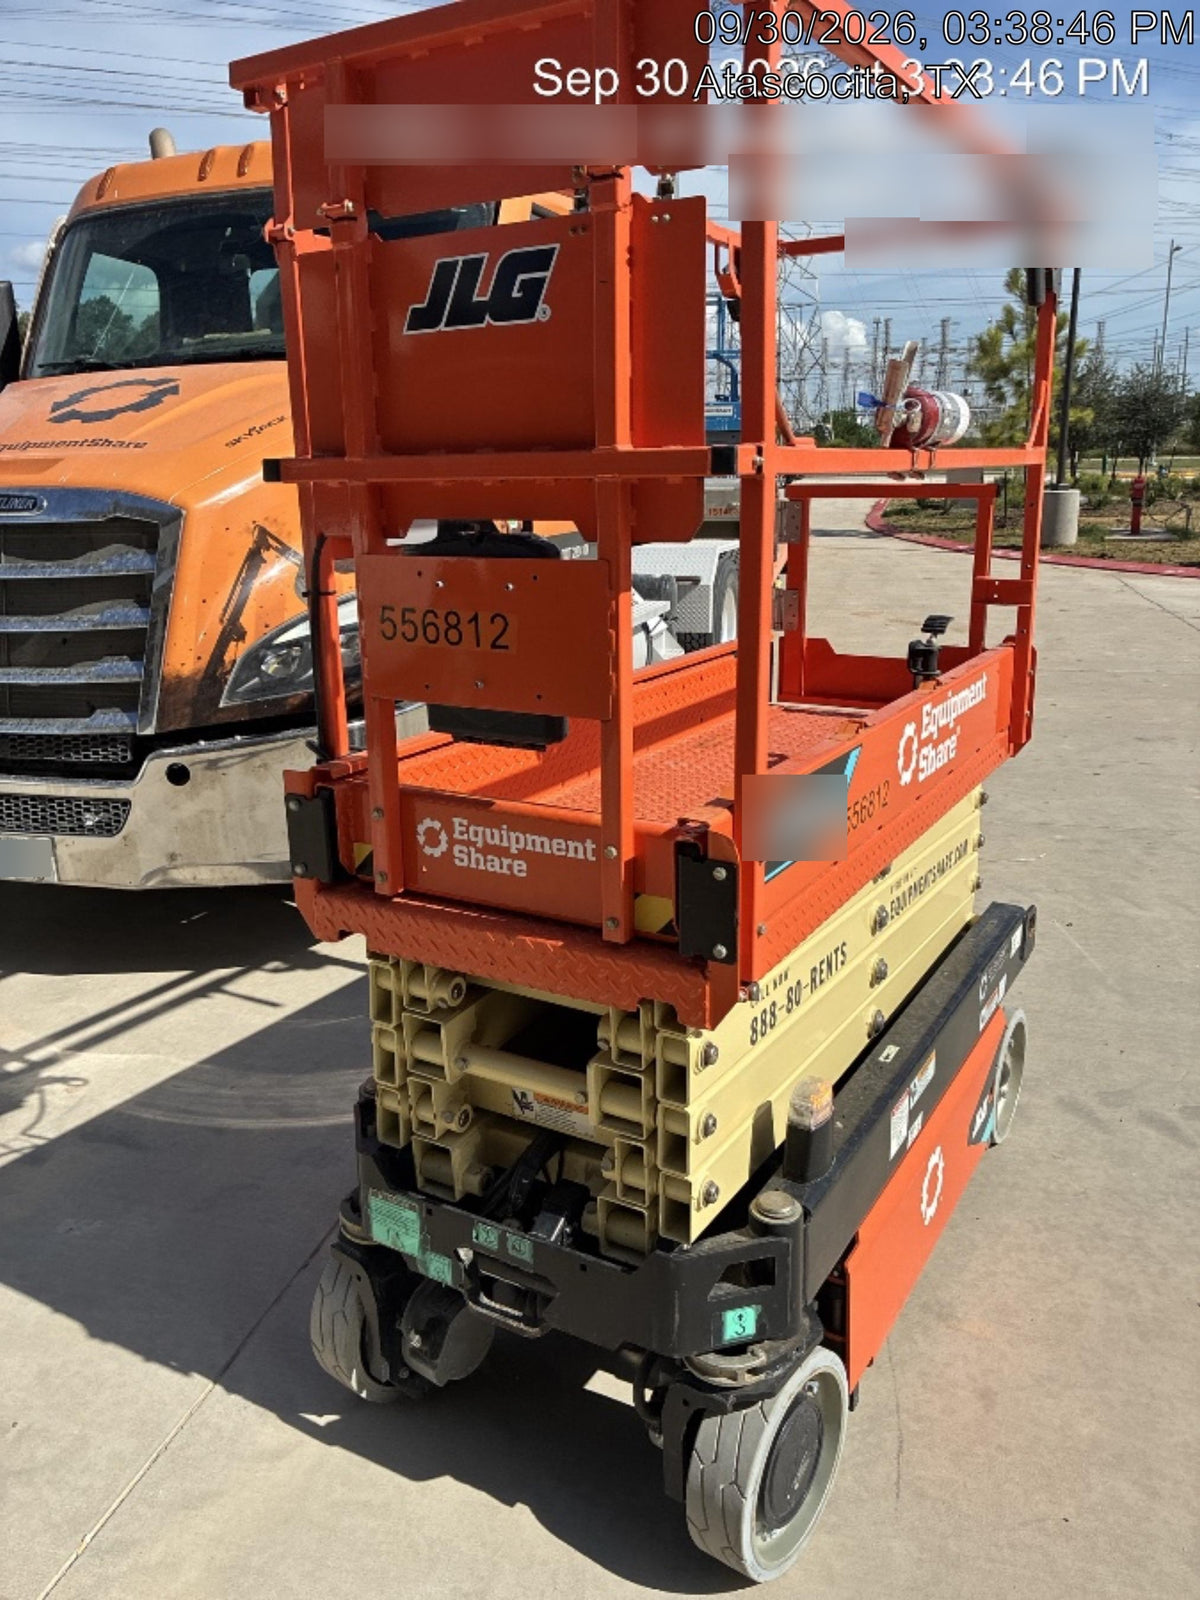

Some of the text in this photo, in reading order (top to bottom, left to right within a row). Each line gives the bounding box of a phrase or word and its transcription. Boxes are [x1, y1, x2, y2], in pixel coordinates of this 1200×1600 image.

[403, 243, 561, 335] JLG
[380, 605, 510, 650] 556812
[921, 672, 987, 740] Equipment
[918, 735, 958, 782] Share
[452, 817, 597, 862] Equipment
[453, 844, 527, 877] Share
[750, 941, 848, 1046] 888-80-RENTS
